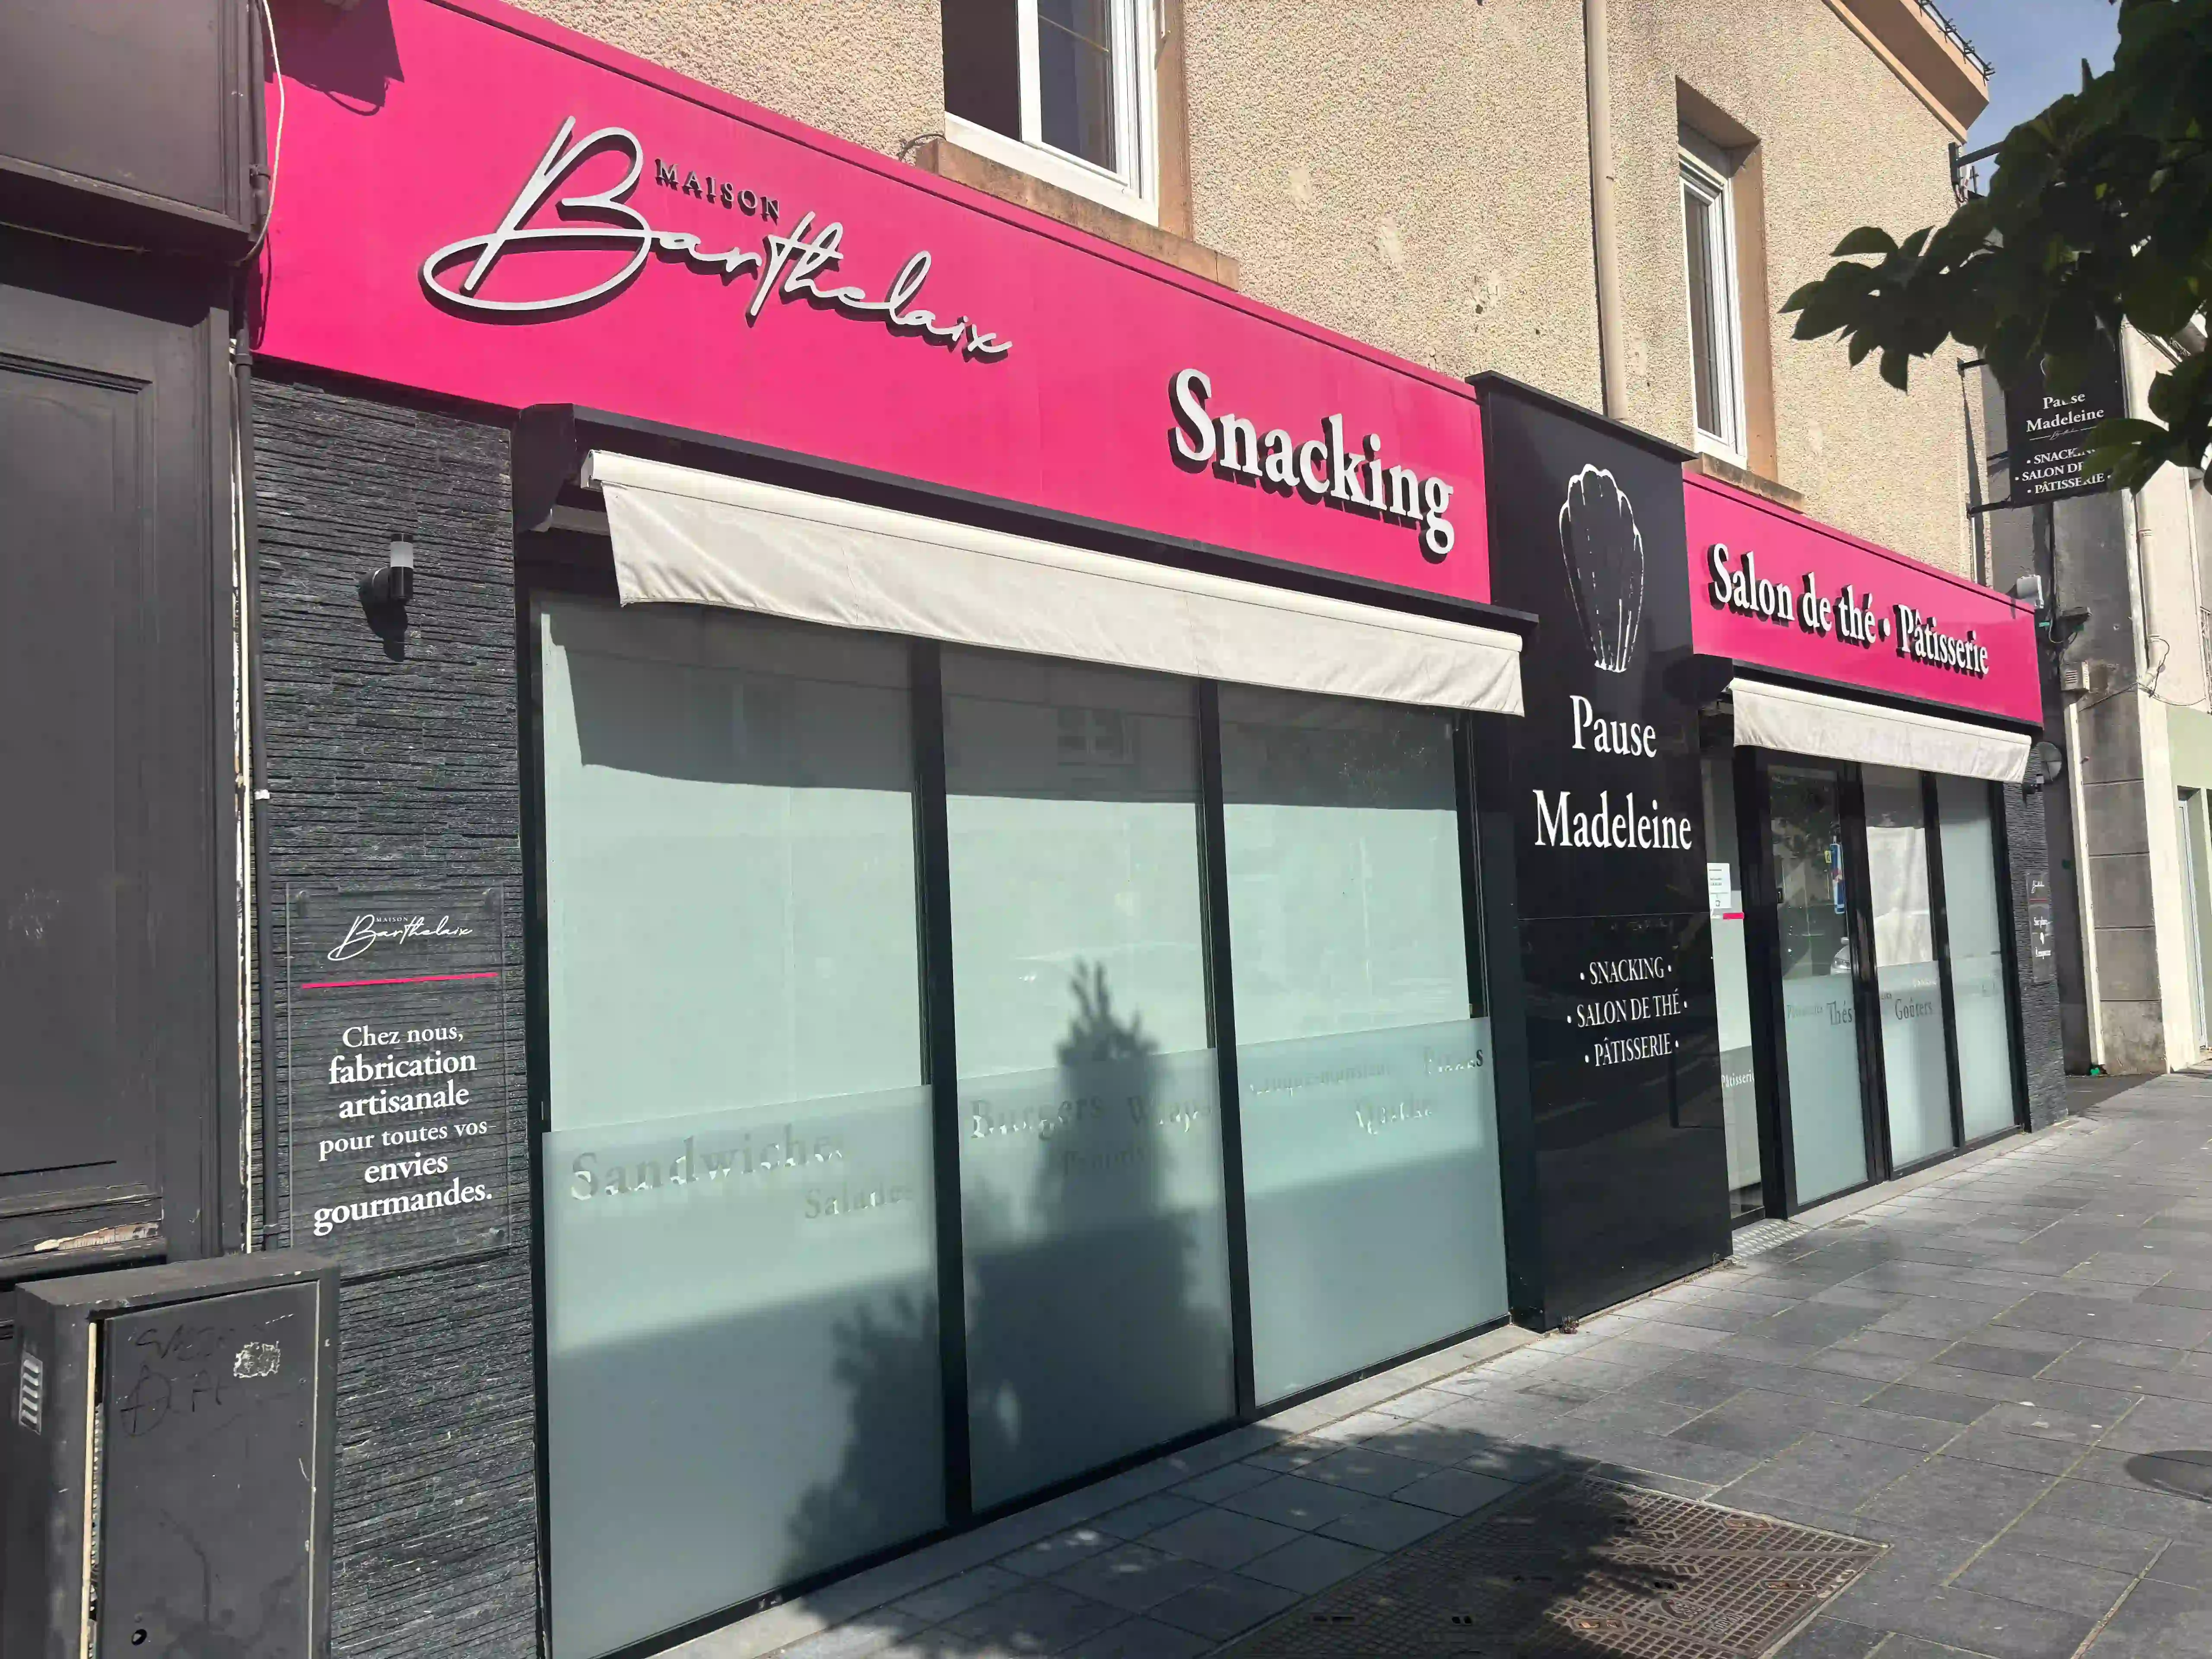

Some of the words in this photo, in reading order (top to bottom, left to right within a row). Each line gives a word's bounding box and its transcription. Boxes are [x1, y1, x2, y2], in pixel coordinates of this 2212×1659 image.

[655, 157, 780, 219] MAISON
[2025, 408, 2105, 432] Madeleine
[1173, 368, 1455, 554] Snacking
[2022, 465, 2065, 481] SALON
[1713, 543, 1795, 621] Salon
[1803, 572, 1832, 632] de
[1839, 585, 1876, 643] thé
[1899, 604, 1989, 675] Pâtisserie
[1569, 694, 1657, 758] Pause
[1532, 788, 1693, 850] Madeleine
[327, 914, 474, 961] Barthelaix
[1589, 956, 1664, 985] SNACKING
[1576, 998, 1628, 1029] SALON
[1631, 995, 1652, 1020] DE
[1652, 988, 1681, 1016] THÉ
[1826, 1000, 1853, 1025] Thés
[1895, 997, 1933, 1020] Goûters
[342, 1025, 400, 1049] Chez
[407, 1023, 464, 1044] nous,
[1594, 1033, 1673, 1068] PÂTISSERIE
[328, 1050, 477, 1085] fabrication
[339, 1079, 470, 1119] artisanale
[318, 1134, 375, 1162] pour
[381, 1124, 448, 1147] toutes
[454, 1122, 488, 1138] vos
[364, 1152, 448, 1185] envies
[313, 1176, 493, 1236] gourmandes.
